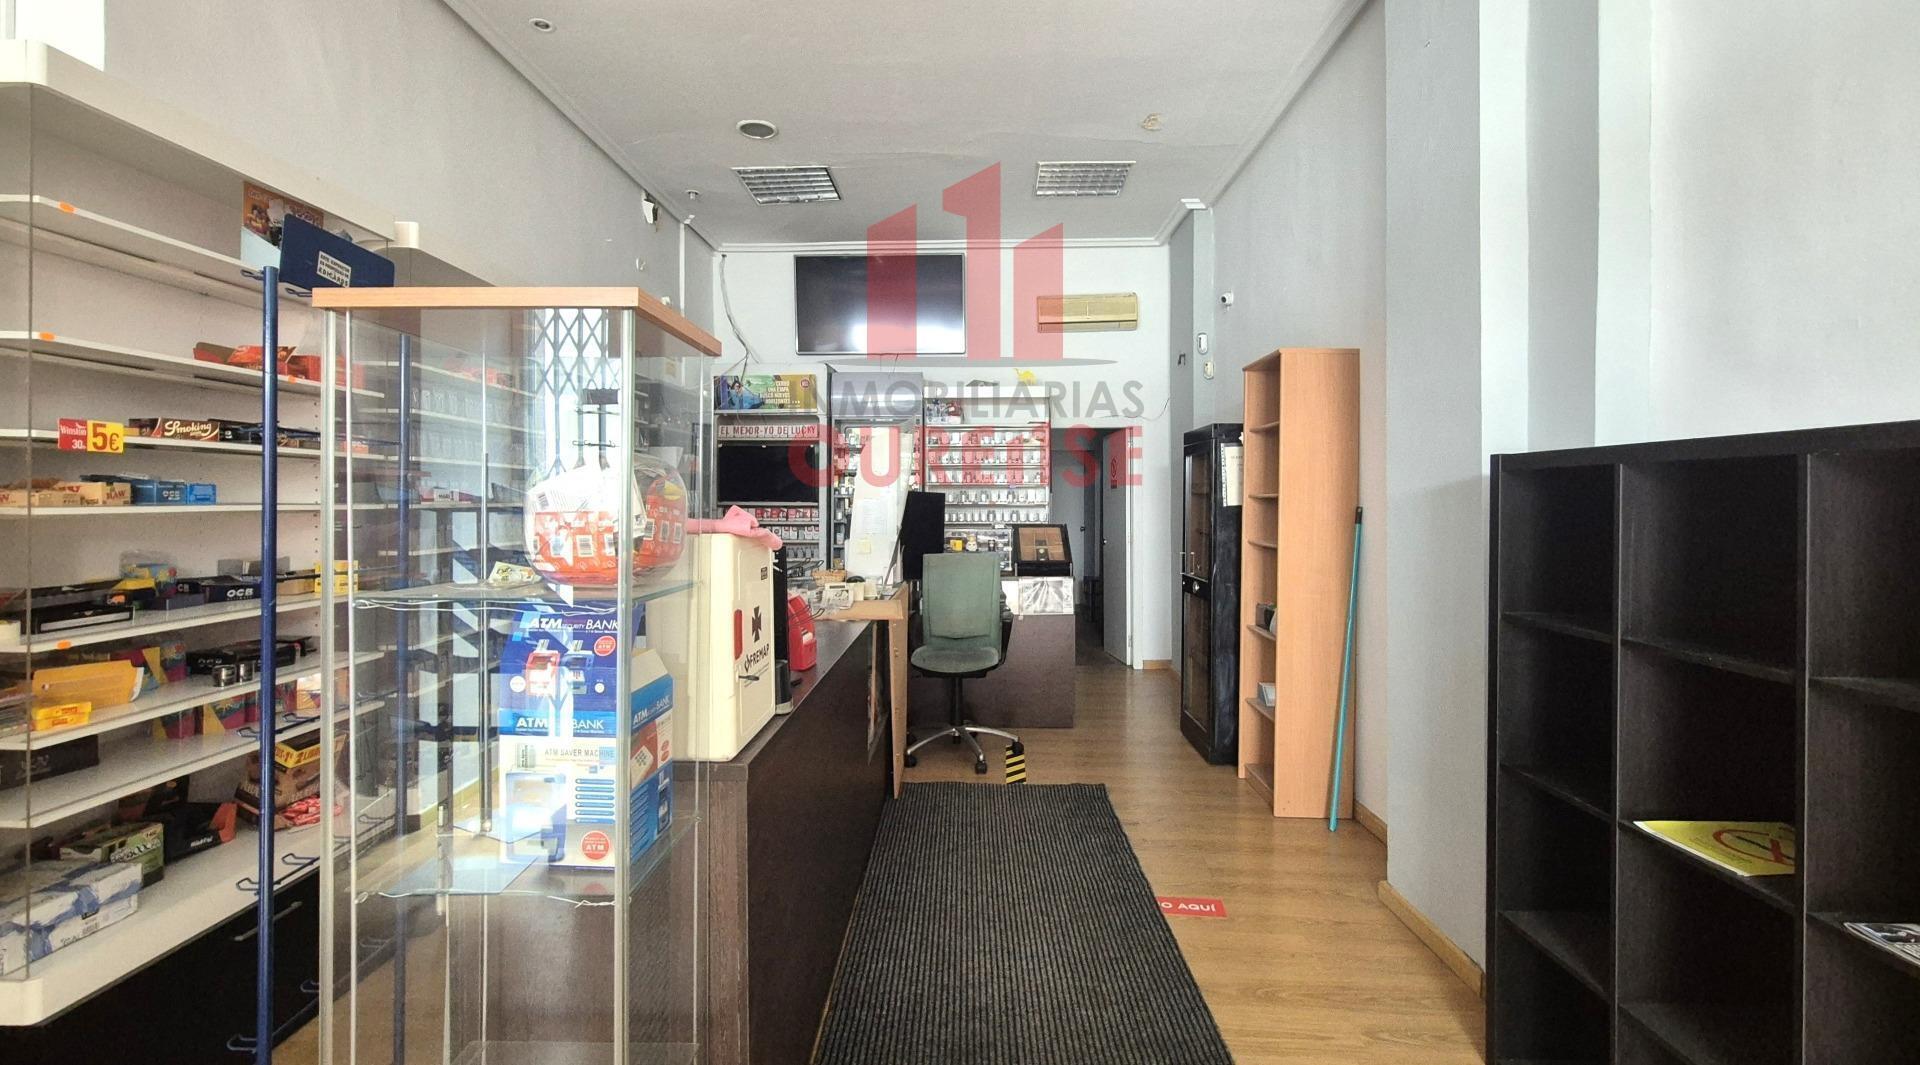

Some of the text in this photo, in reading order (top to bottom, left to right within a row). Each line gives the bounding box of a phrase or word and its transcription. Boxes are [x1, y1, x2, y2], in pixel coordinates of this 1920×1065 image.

[60, 424, 87, 436] Winston
[164, 420, 212, 437] Smoking
[720, 426, 730, 435] EL
[777, 426, 788, 435] DE
[791, 425, 816, 435] LUCKY
[106, 489, 126, 500] RAW
[226, 587, 254, 598] OCB
[529, 617, 563, 629] ATM
[750, 643, 769, 668] FREMAP
[633, 707, 648, 726] ATM
[516, 717, 604, 730] ATM BANK
[584, 748, 615, 759] MACHINE
